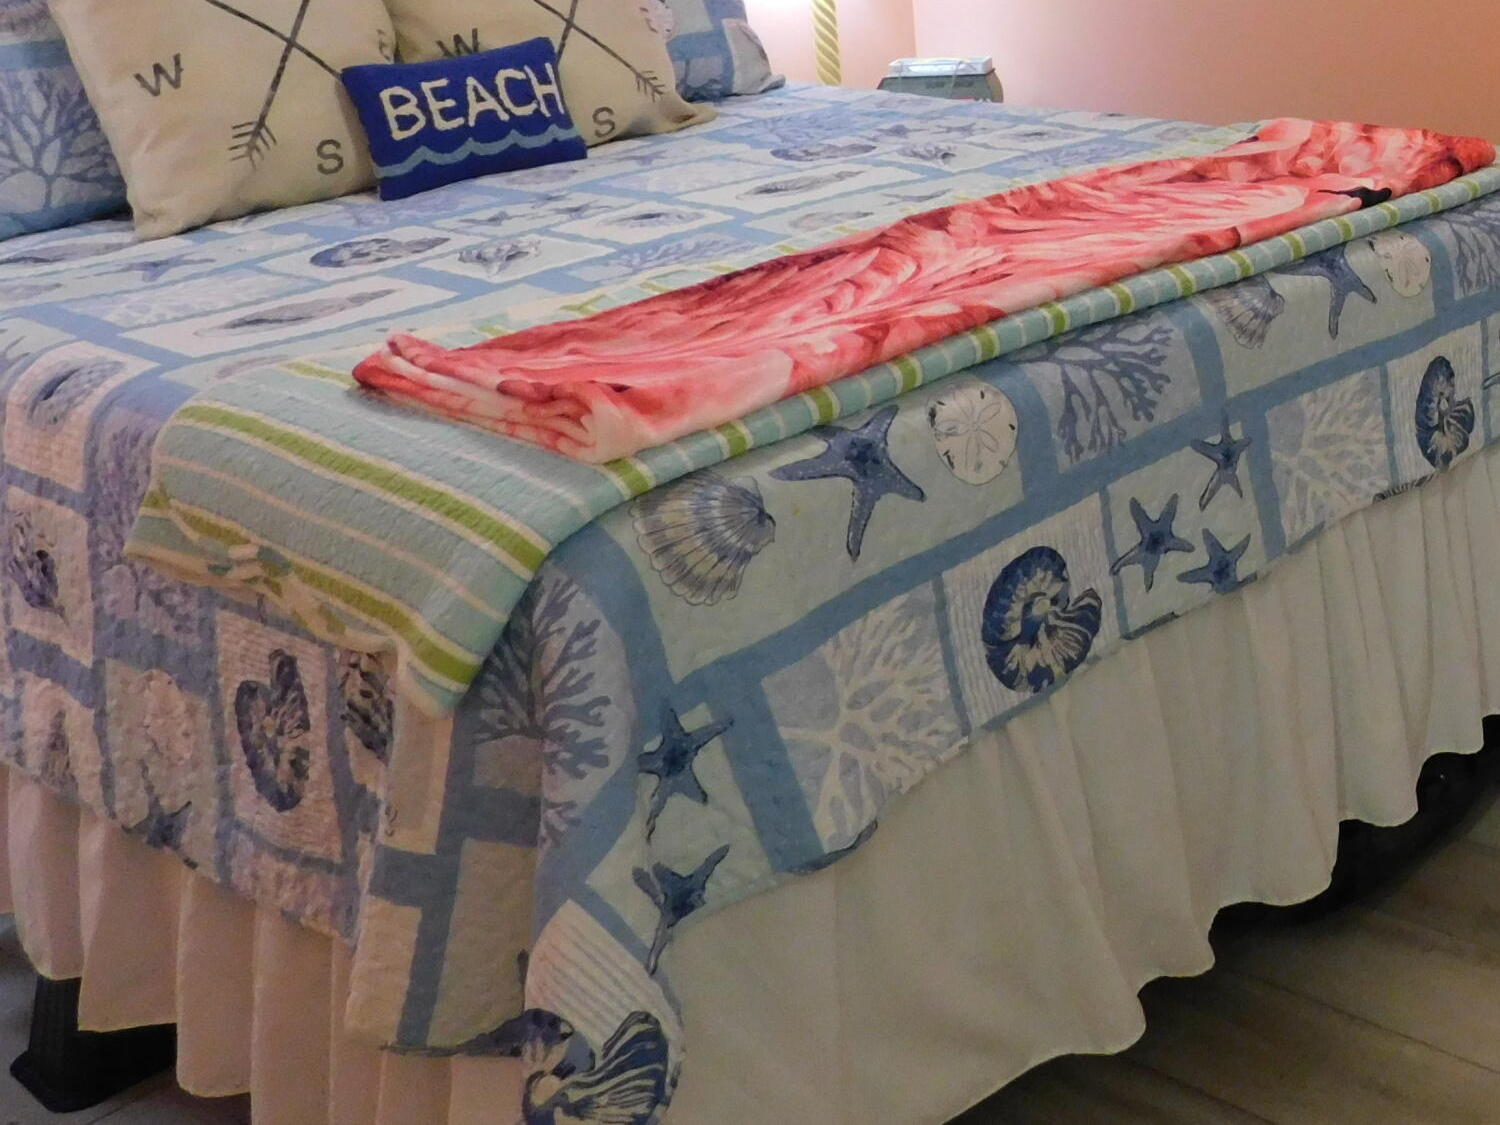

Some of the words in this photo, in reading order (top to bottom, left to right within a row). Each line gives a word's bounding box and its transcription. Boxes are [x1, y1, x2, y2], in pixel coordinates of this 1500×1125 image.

[133, 52, 184, 98] W
[379, 62, 566, 141] BEACH
[591, 106, 616, 137] S
[316, 138, 345, 175] S
